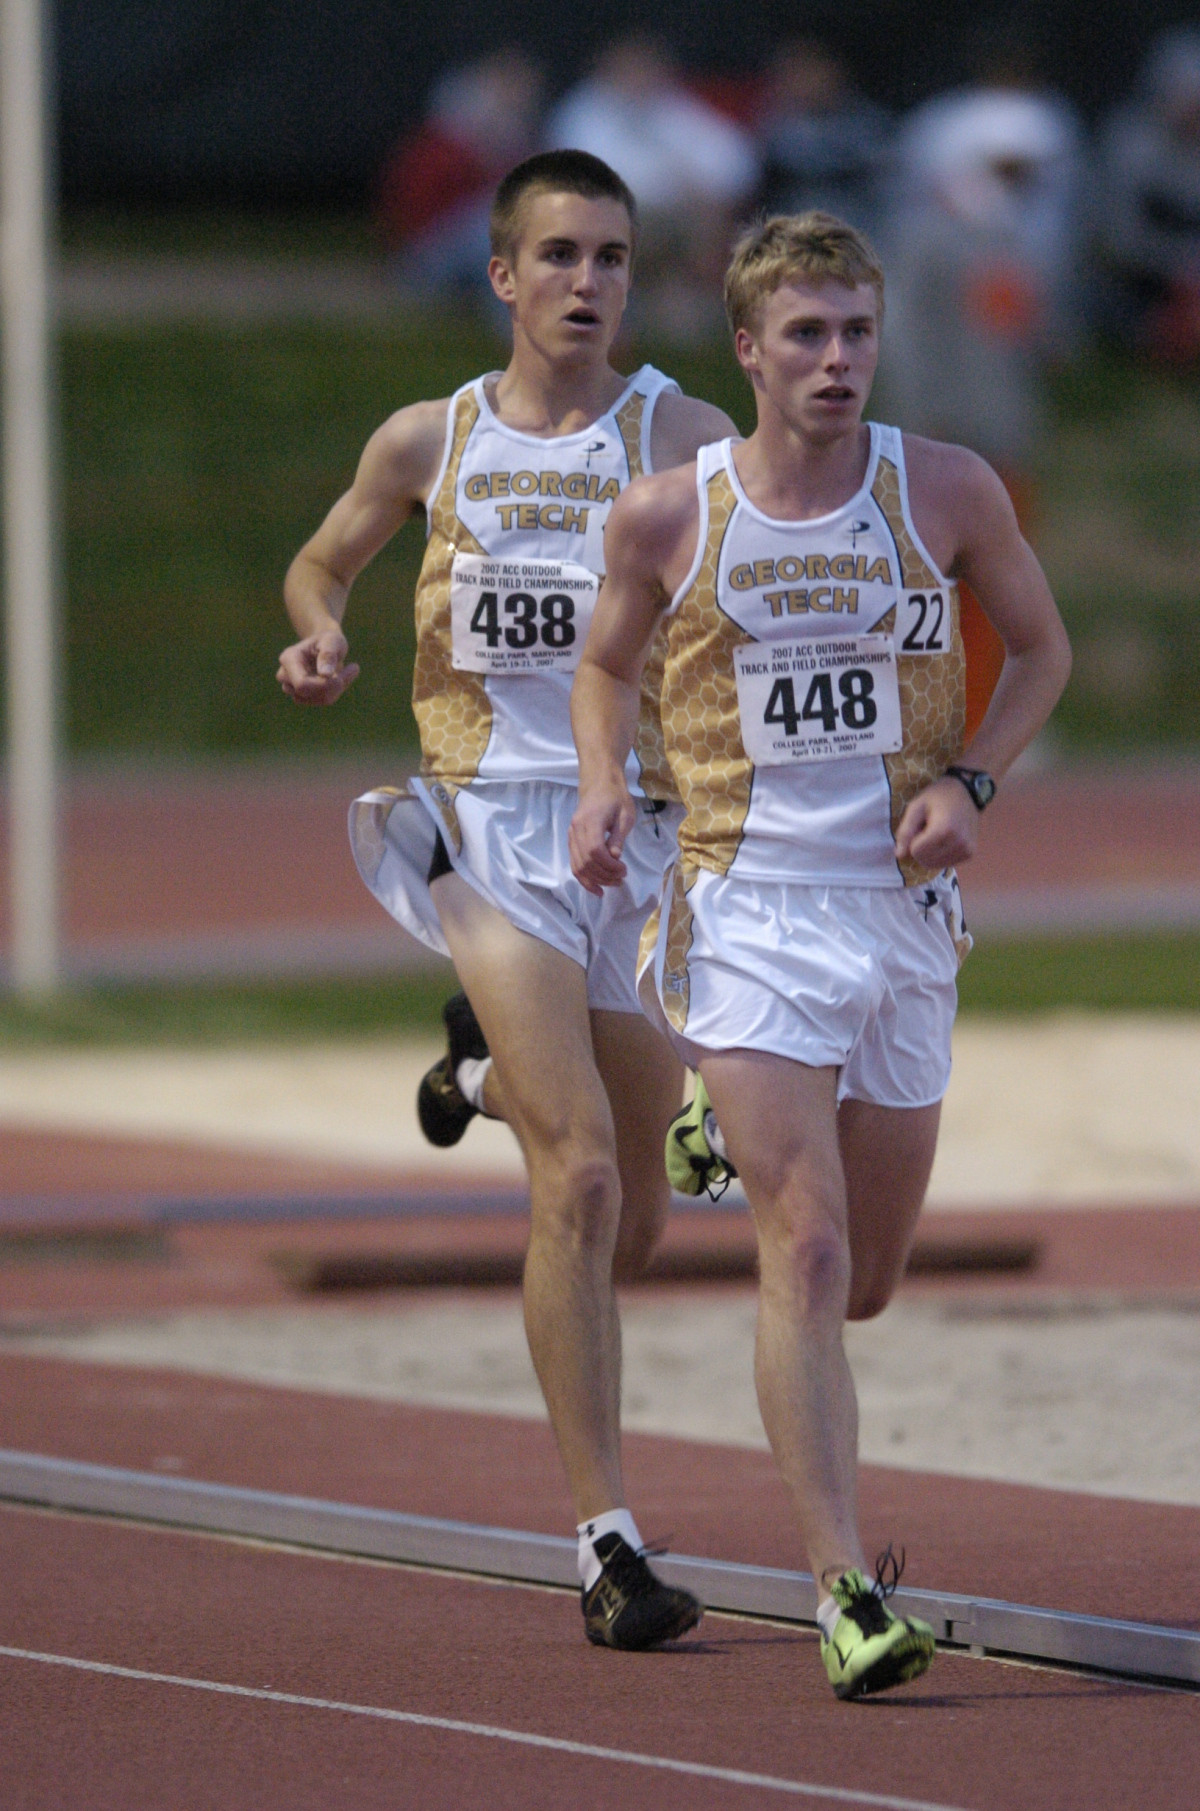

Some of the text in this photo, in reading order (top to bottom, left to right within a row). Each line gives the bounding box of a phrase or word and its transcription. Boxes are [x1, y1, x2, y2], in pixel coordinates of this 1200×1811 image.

[465, 471, 620, 503] GEORGIA
[496, 503, 590, 534] TECH
[455, 573, 594, 591] TRACK AND FIELD CHAMPIONSHIPS
[481, 564, 562, 576] 2007 ACC OUTDOOR
[729, 554, 893, 591] GEORGIA
[763, 587, 859, 618] TECH
[470, 591, 576, 649] 438
[902, 592, 944, 651] 22
[475, 651, 504, 659] COLLEGE
[507, 652, 528, 660] PARK,
[772, 642, 857, 660] 2007 ACC OUTDOOR
[491, 661, 507, 669] April
[536, 659, 554, 667] 2007
[740, 652, 891, 676] TRACK AND FIELD CHAMPIONSHIPS
[763, 668, 878, 737] 448
[773, 732, 875, 750] COLLEGE PARK, MARYLAND
[792, 748, 809, 757] April
[839, 743, 857, 752] 2007
